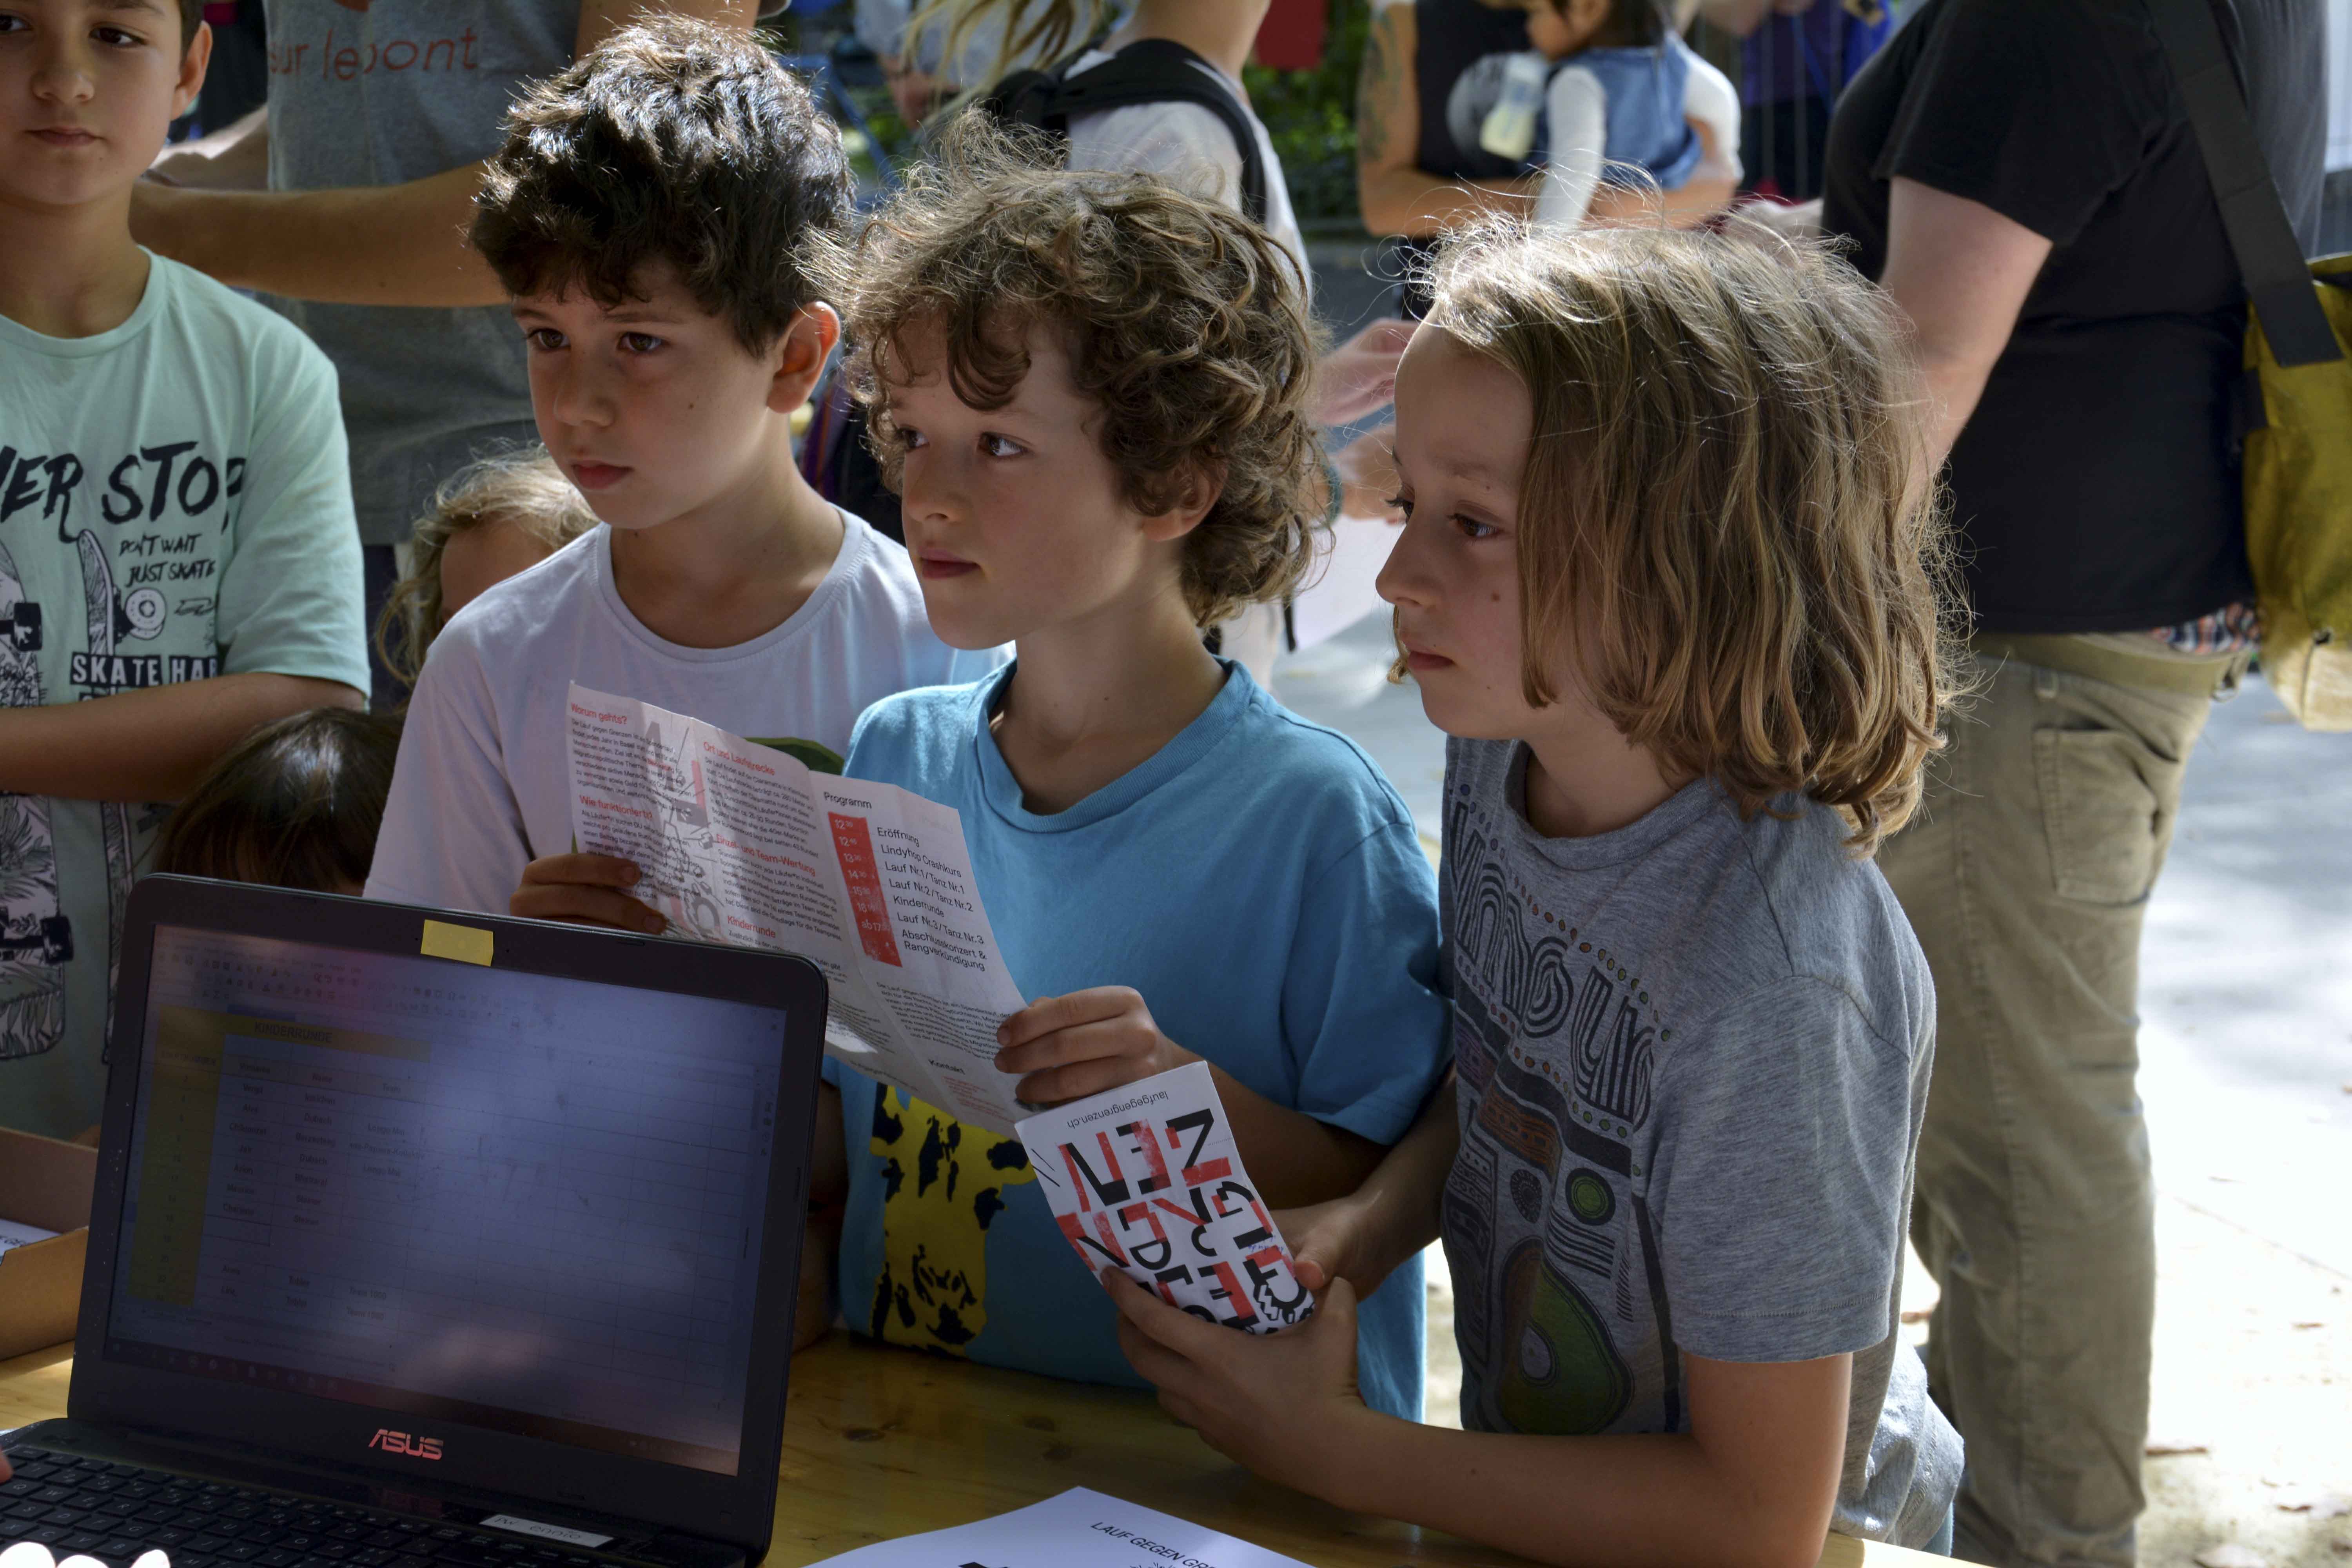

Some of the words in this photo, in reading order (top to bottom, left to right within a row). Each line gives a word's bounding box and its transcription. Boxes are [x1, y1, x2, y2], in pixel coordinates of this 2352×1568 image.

[161, 533, 203, 554] WAIT
[124, 561, 169, 588] JUST
[168, 558, 216, 581] SKATE
[73, 655, 159, 686] SKATE
[571, 702, 596, 718] Worum
[598, 713, 628, 724] gehts?
[592, 725, 608, 734] gegen
[609, 728, 632, 738] Grenzen
[601, 736, 612, 744] Jahr
[619, 739, 635, 749] Basel
[703, 741, 716, 753] Ort
[716, 749, 730, 760] und
[580, 795, 596, 806] Wie
[823, 791, 872, 809] Programm
[877, 826, 920, 847] Eröffnung
[716, 834, 739, 850] Einzel-
[740, 845, 755, 857] und
[755, 849, 816, 878] Team-Wertung
[880, 844, 922, 863] Lindyhop
[922, 855, 962, 878] Crashkurs
[884, 861, 907, 873] Lauf
[948, 880, 965, 895] Nr.1
[889, 878, 911, 891] Lauf
[954, 897, 974, 912] Nr.2
[893, 895, 945, 918] Kinderrunde
[727, 915, 776, 938] Kinderrunde
[897, 912, 919, 924] Lauf
[964, 931, 985, 945] Nr.3
[902, 928, 977, 958] Abschlusskonzert
[904, 940, 985, 973] Rangverkündigung
[254, 1022, 333, 1044] KINDERRUNDE
[1067, 1091, 1169, 1129] laufgegengrenzen.ch
[368, 1428, 444, 1461] ASUS
[1091, 1522, 1134, 1539] LAUF
[1130, 1537, 1185, 1561] GEGEN
